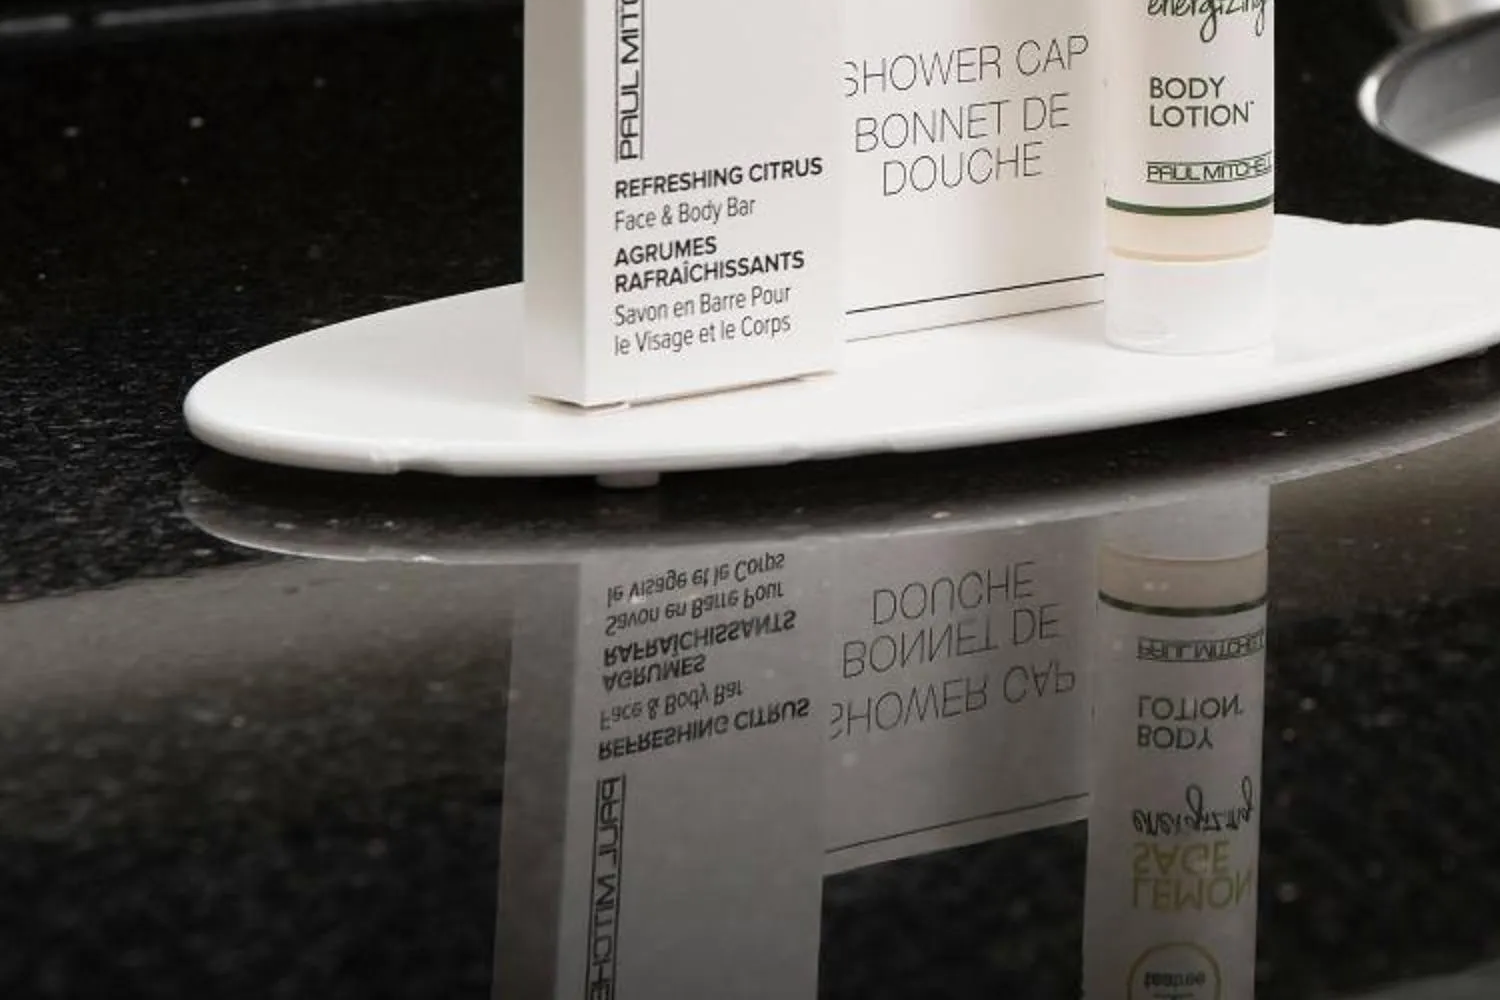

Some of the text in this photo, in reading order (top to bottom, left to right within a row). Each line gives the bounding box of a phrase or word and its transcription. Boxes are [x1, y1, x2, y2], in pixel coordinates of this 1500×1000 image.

[844, 34, 1089, 98] SHOWER CAP
[1150, 75, 1226, 101] BODY
[620, 69, 640, 160] PAUL
[855, 92, 1070, 153] BONNET DE
[1150, 101, 1250, 128] LOTION
[615, 156, 824, 199] REFRESHING CITRUS
[883, 141, 1043, 197] DOUCHE
[1147, 164, 1201, 181] PAUL
[614, 196, 757, 232] Face & Body Bar
[614, 236, 718, 267] AGRUMES
[615, 250, 805, 293] RAFRAÎCHISSANTS
[614, 285, 792, 327] Savon en Barre Pour
[614, 314, 791, 356] le Visage et le Corps
